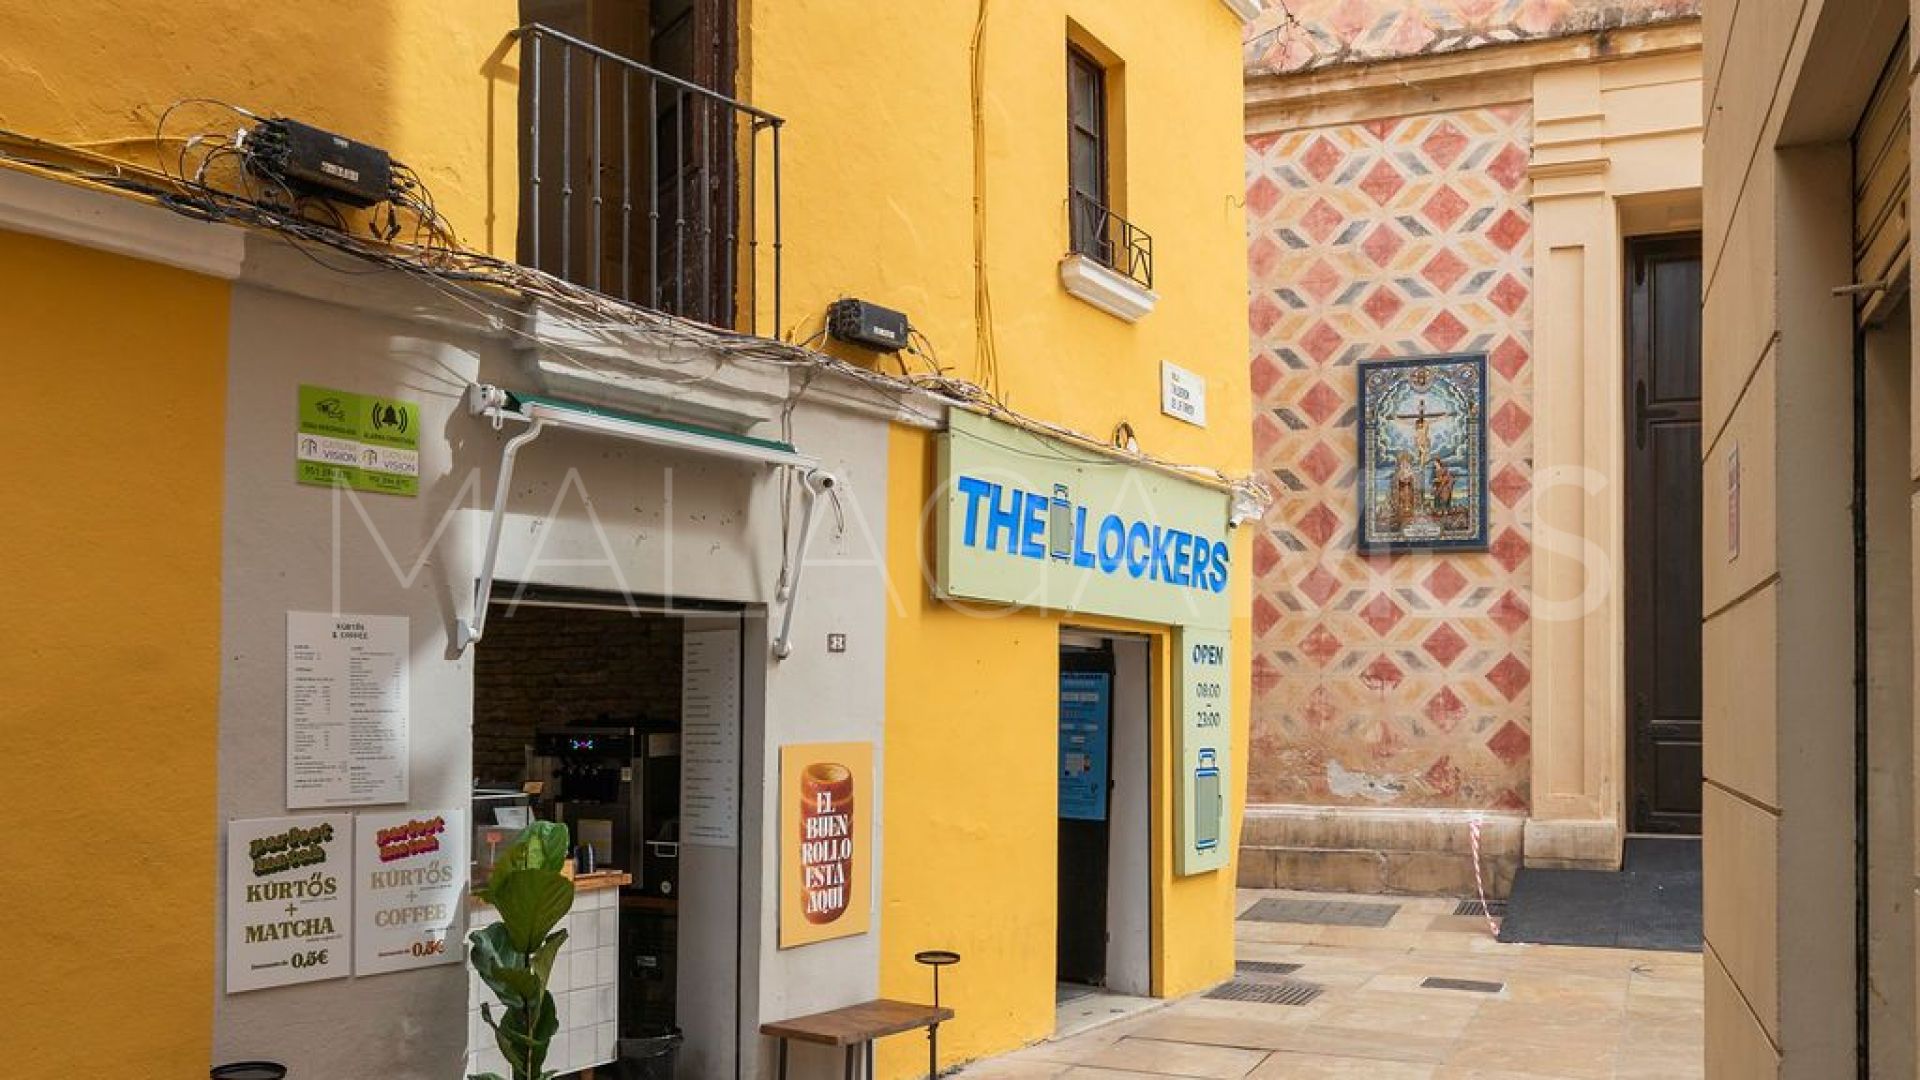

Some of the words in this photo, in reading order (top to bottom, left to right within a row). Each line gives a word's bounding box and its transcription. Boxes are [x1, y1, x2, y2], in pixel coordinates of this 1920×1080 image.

[322, 450, 357, 464] VISION
[383, 460, 416, 473] VISION
[957, 475, 1049, 560] THE
[1073, 505, 1230, 593] LOCKERS
[1192, 644, 1224, 665] OPEN
[816, 791, 836, 815] EL
[805, 814, 849, 840] BUEN
[801, 837, 853, 866] ROLLO
[375, 903, 447, 927] COFFEE
[245, 916, 335, 944] MATCHA
[291, 949, 329, 969] 0,5€
